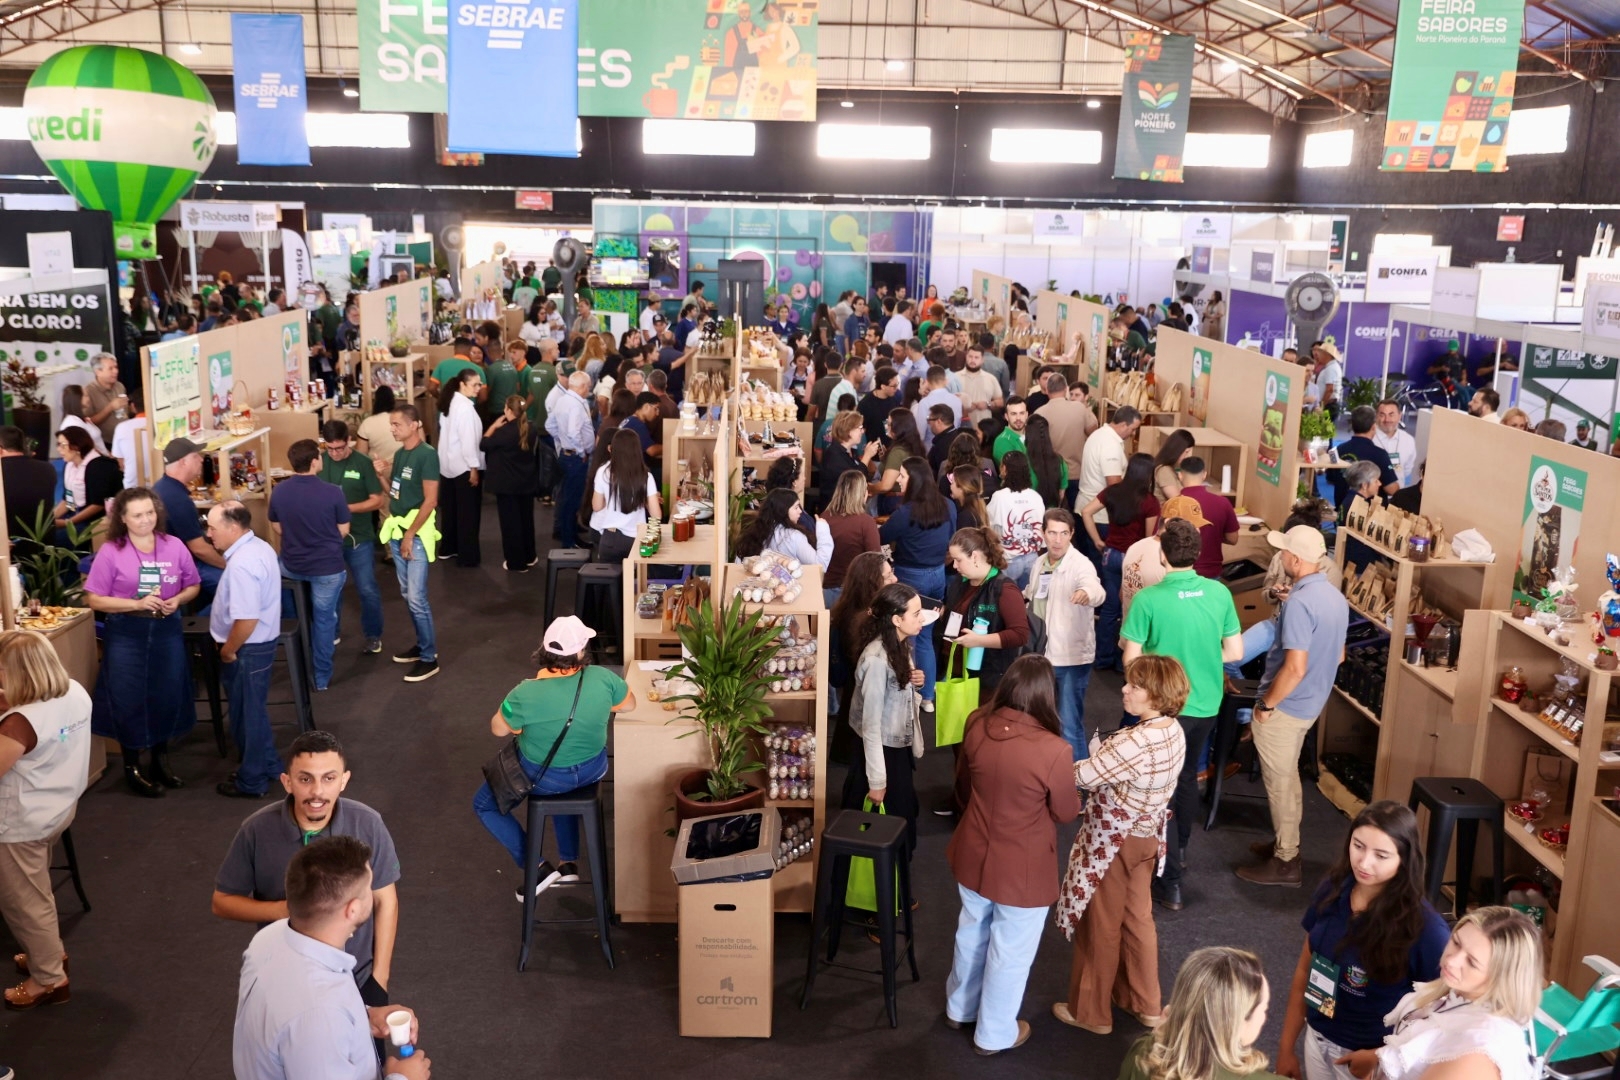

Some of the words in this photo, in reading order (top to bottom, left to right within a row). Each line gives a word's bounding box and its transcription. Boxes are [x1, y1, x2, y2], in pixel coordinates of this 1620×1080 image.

[1420, 0, 1475, 14] FEIRA
[457, 5, 565, 30] SEBRAE
[1417, 16, 1508, 32] SABORES
[1416, 34, 1437, 43] Norte
[1438, 34, 1467, 43] Pioneiro
[1469, 35, 1479, 43] do
[1480, 35, 1507, 43] Paraná
[240, 83, 299, 98] SEBRAE
[1140, 111, 1171, 121] NORTE
[1134, 119, 1176, 129] PIONEIRO
[202, 210, 250, 222] Robusta
[1390, 267, 1428, 276] CONFEA
[27, 293, 67, 308] SEM
[70, 294, 99, 309] OS
[8, 314, 82, 330] CLORO!
[1429, 328, 1459, 338] CREA
[696, 995, 758, 1006] cartrom
